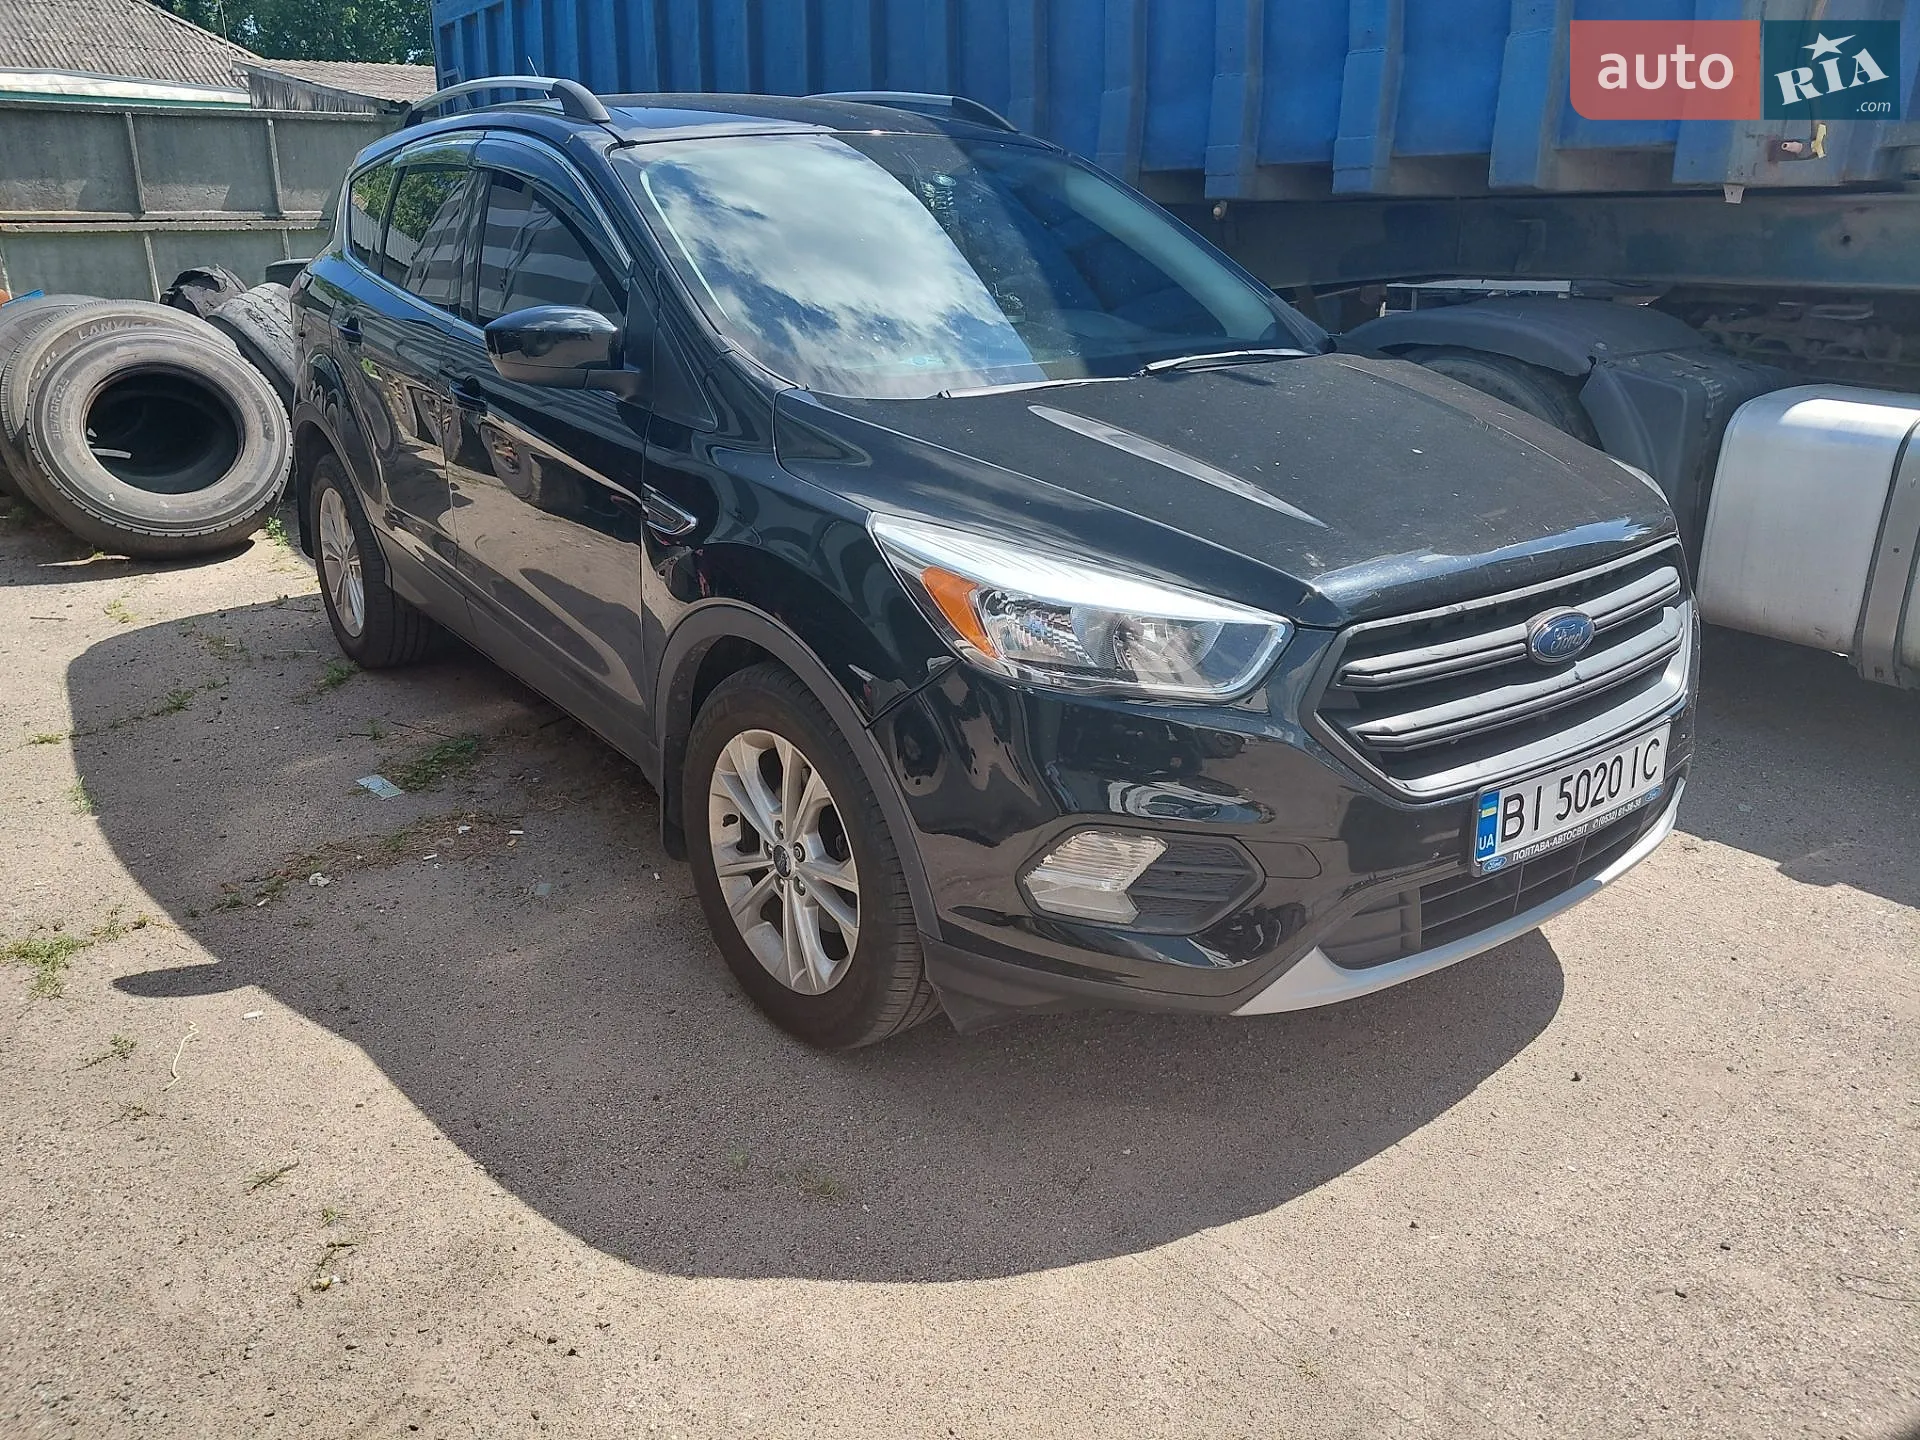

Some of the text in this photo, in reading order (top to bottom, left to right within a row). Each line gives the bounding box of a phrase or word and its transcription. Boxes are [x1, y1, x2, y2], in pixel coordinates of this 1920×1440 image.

[1551, 623, 1584, 652] Ford
[1500, 739, 1661, 843] BI 5020 IC
[1478, 834, 1494, 851] UA
